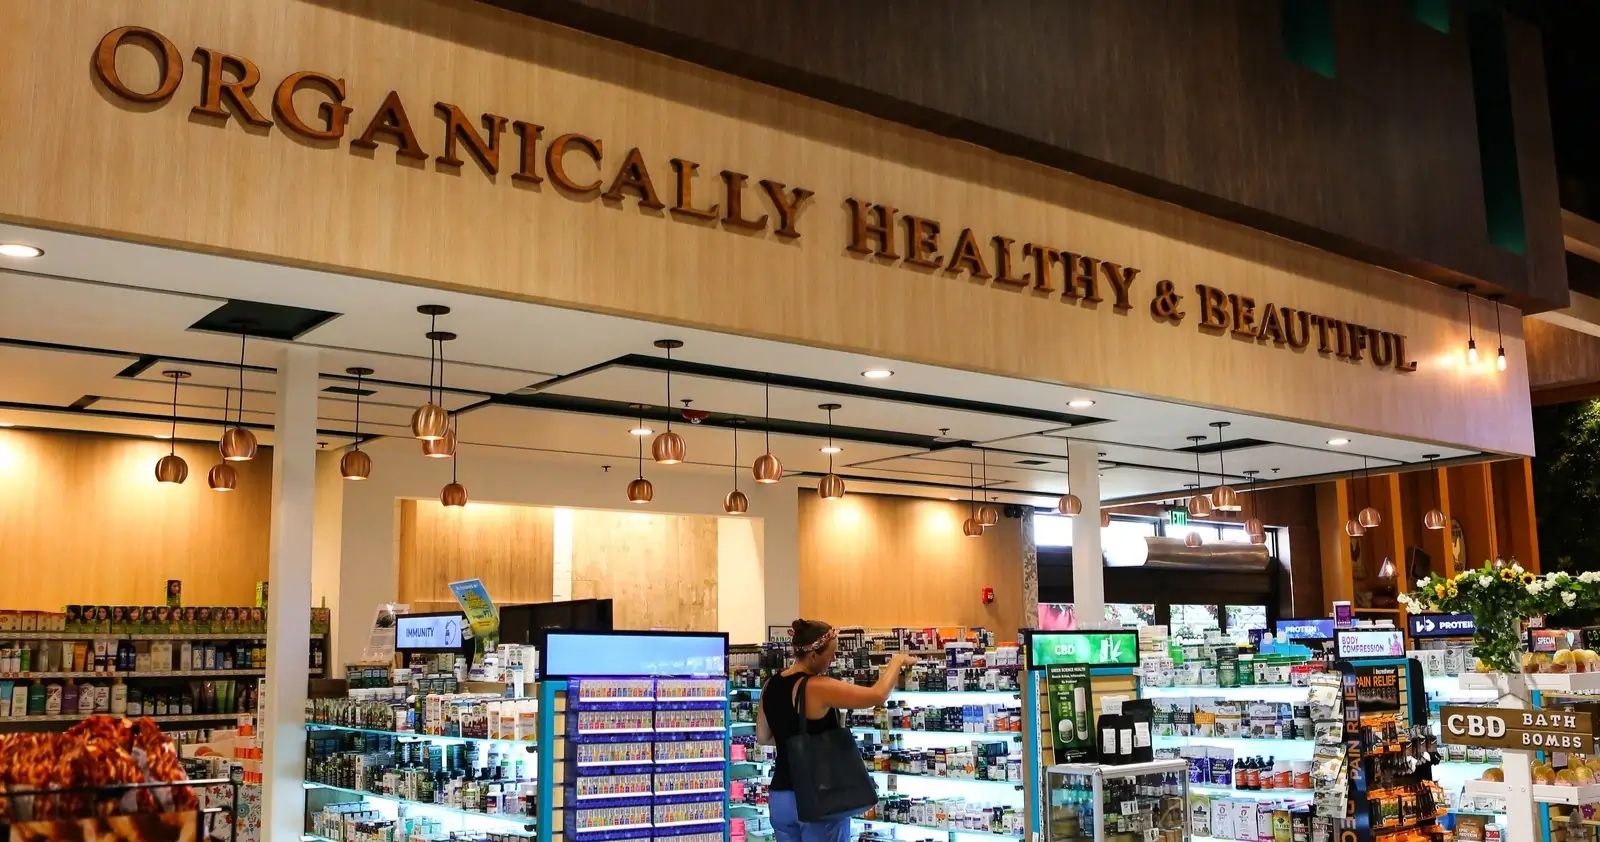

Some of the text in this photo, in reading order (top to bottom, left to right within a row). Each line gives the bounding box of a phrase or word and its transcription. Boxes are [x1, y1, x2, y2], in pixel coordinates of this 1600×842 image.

[95, 26, 1417, 372] ORGANICALLY HEALTHY & BEAUTIFUL
[405, 627, 435, 637] IMMUNITY
[1285, 625, 1317, 633] PROTEIN
[1341, 636, 1359, 644] BODY
[1055, 645, 1074, 656] CBD
[1342, 644, 1385, 653] COMPRESSION
[1373, 675, 1397, 687] RELIEF
[1447, 714, 1506, 738] CBD
[1522, 713, 1577, 729] BATH
[1343, 675, 1362, 780] PAIN RELIEF
[1522, 732, 1582, 748] BOMBS
